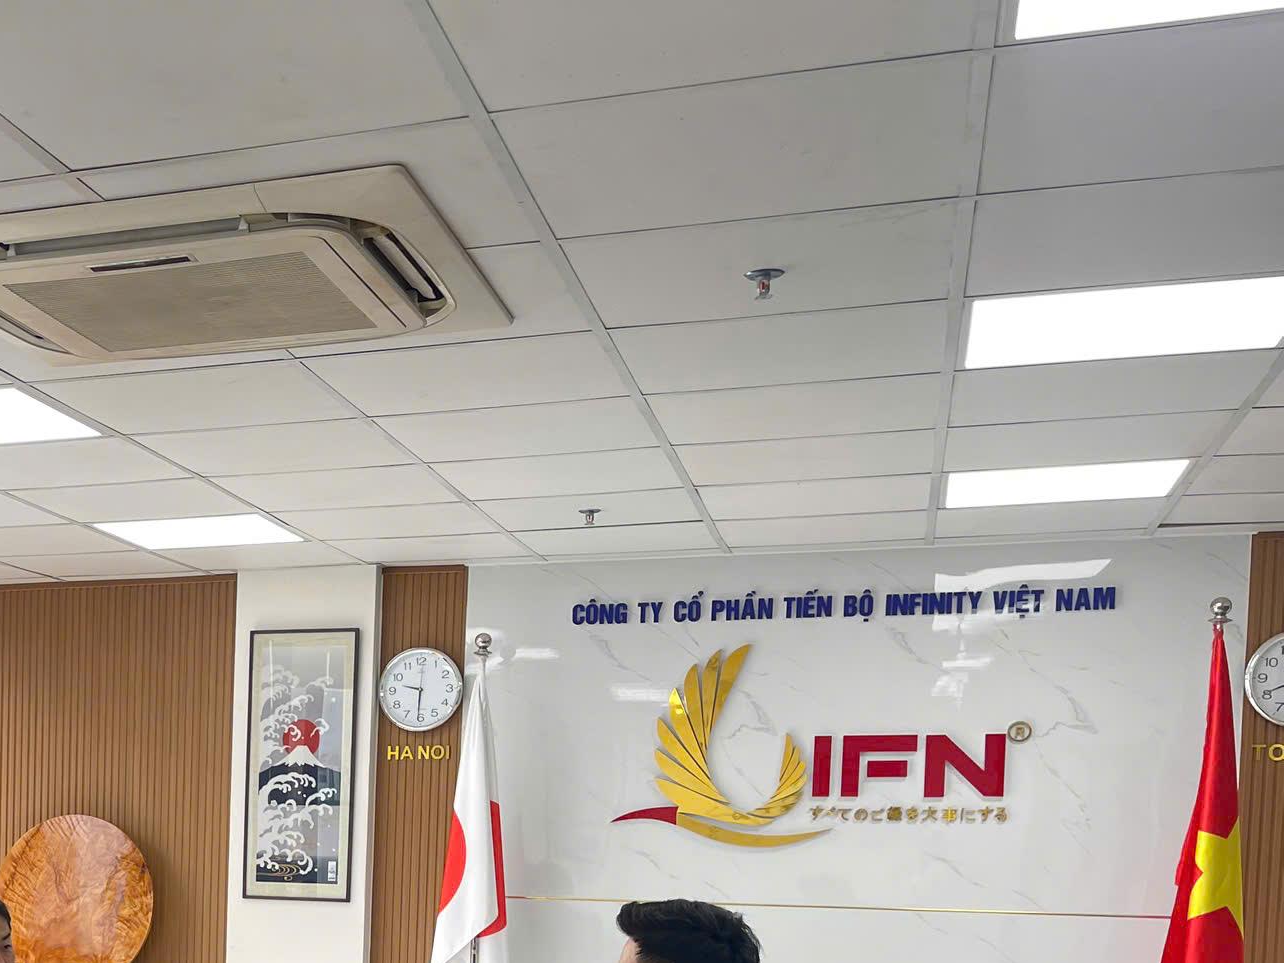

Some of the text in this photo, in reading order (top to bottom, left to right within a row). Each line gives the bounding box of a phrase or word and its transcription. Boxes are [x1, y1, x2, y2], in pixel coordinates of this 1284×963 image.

[572, 584, 1116, 626] CÔNG TY CỔ PHẦN TIẾN BỘ INFINITY VIỆT NAM
[1265, 657, 1279, 668] 10
[1257, 673, 1268, 683] 9
[1262, 690, 1272, 700] 8
[812, 733, 1007, 798] IFN
